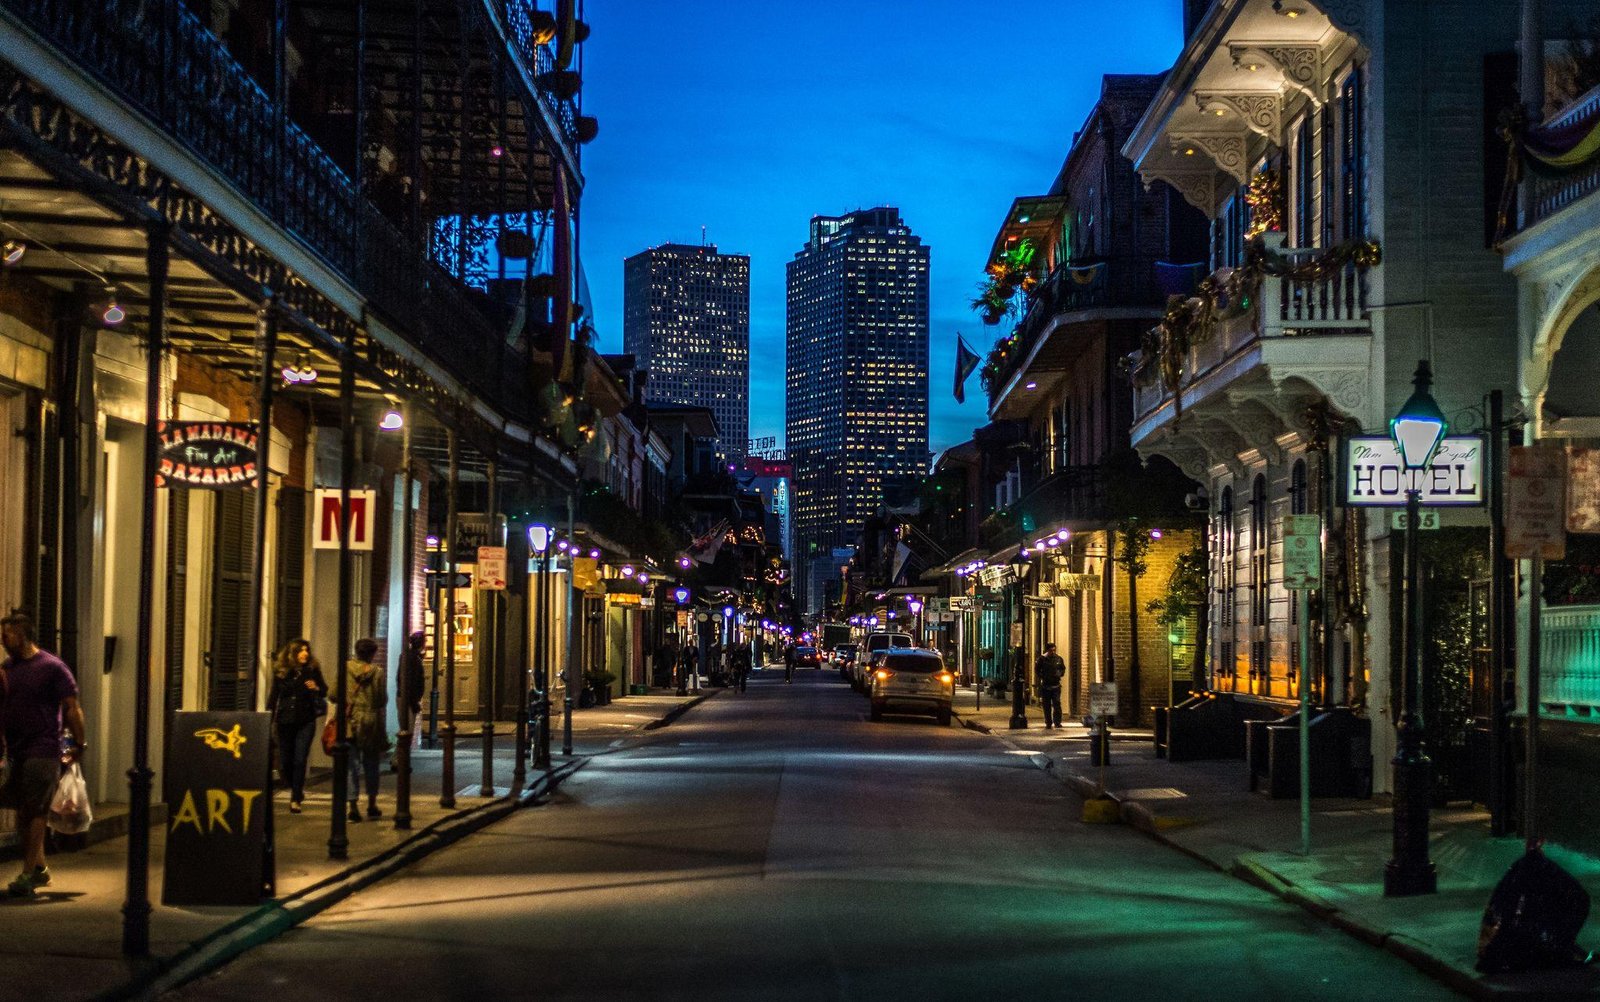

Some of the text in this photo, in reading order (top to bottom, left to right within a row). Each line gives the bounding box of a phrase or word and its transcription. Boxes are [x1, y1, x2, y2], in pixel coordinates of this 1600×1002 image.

[160, 424, 257, 450] LA MADAMA
[213, 447, 236, 464] Art
[1434, 445, 1477, 463] Ryal
[160, 459, 257, 484] BAZARRE
[1353, 464, 1477, 496] HOTEL
[320, 497, 367, 543] M
[1398, 513, 1434, 528] 95
[170, 789, 263, 835] ART
